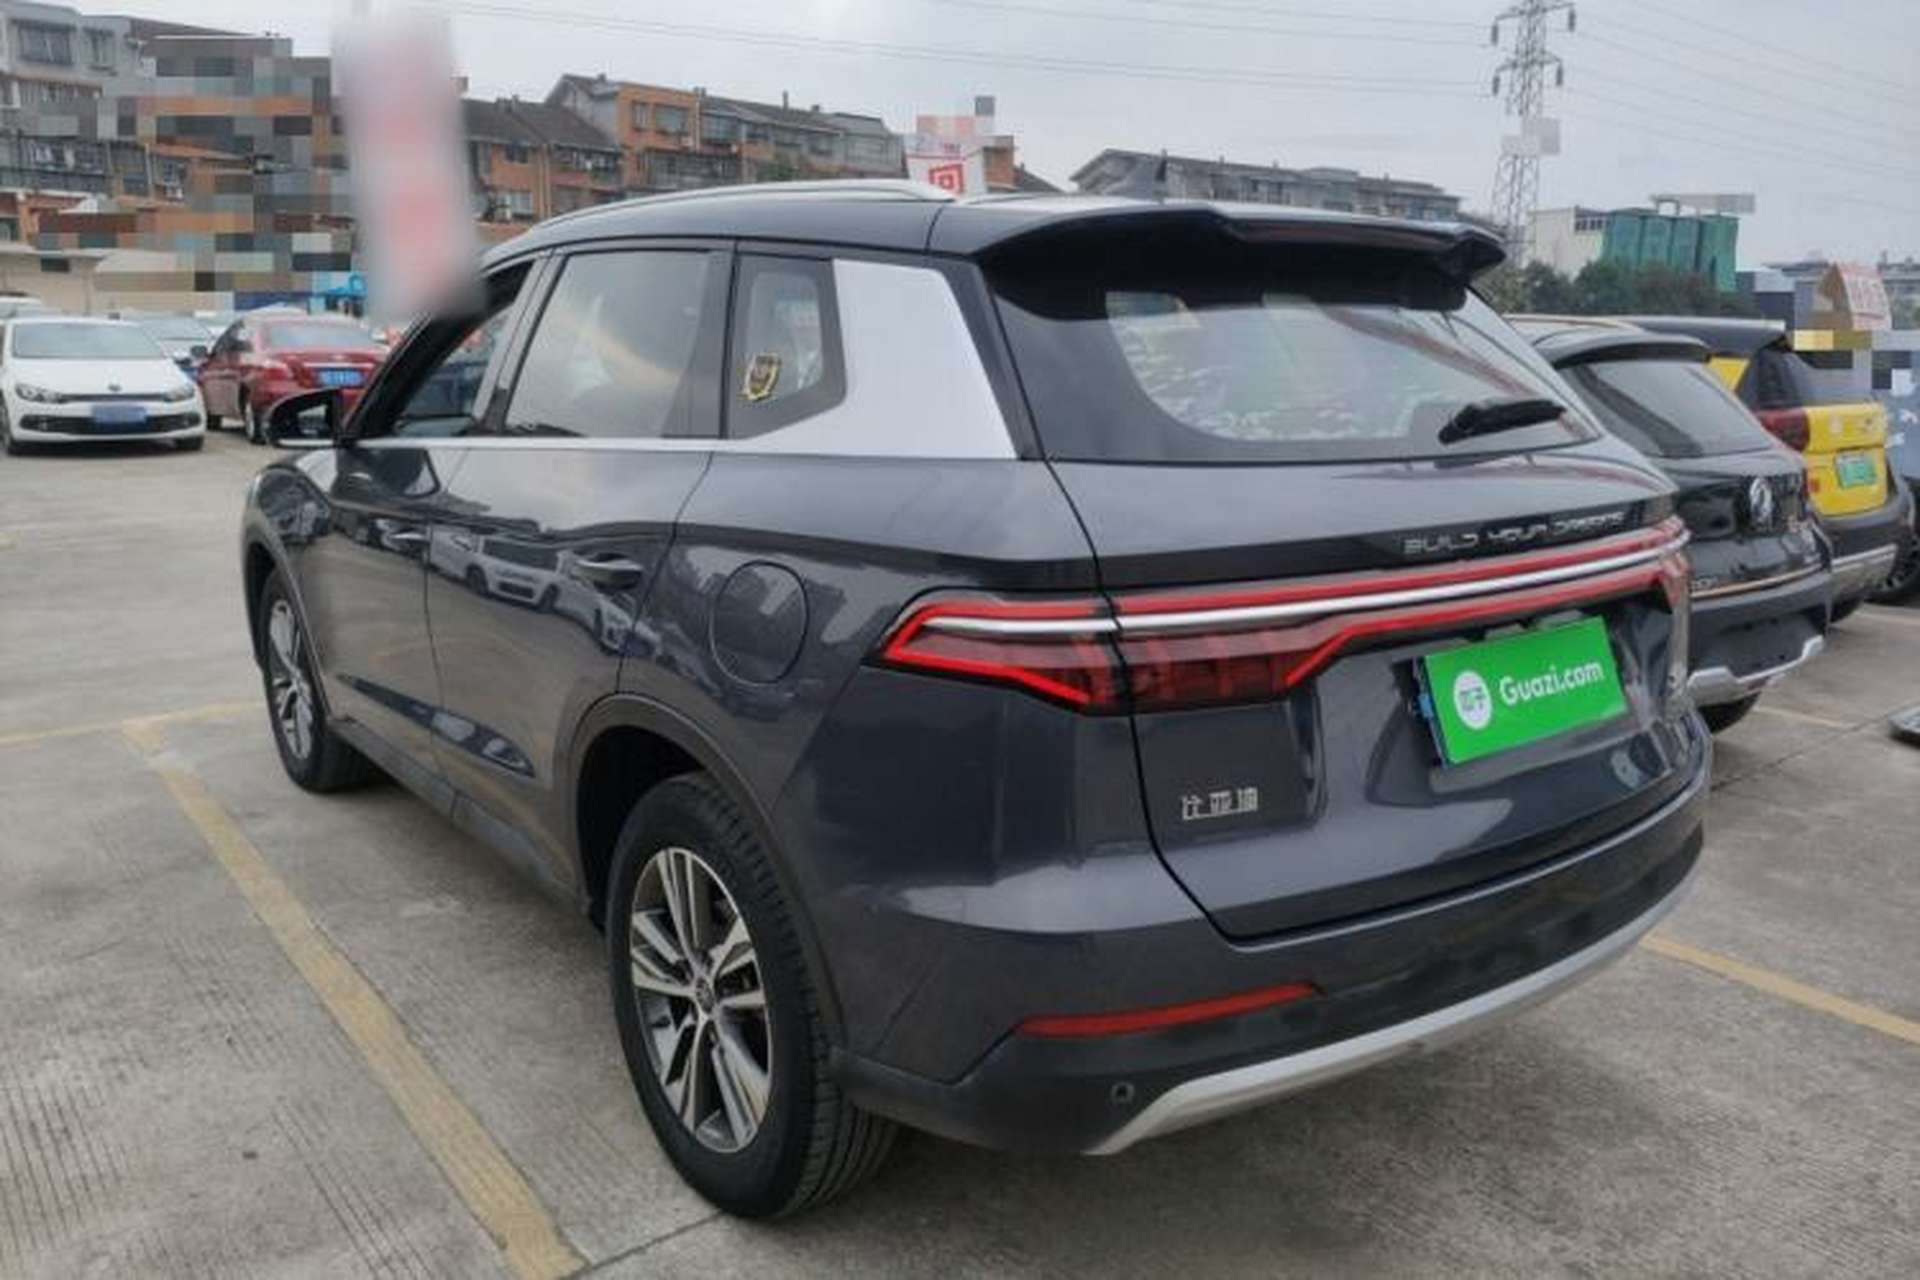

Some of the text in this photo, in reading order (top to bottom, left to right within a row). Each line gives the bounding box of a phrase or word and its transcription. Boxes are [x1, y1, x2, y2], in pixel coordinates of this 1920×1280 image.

[1403, 533, 1478, 554] BUILD
[1487, 523, 1548, 542] YOUR
[1182, 787, 1258, 820] 比亚迪
